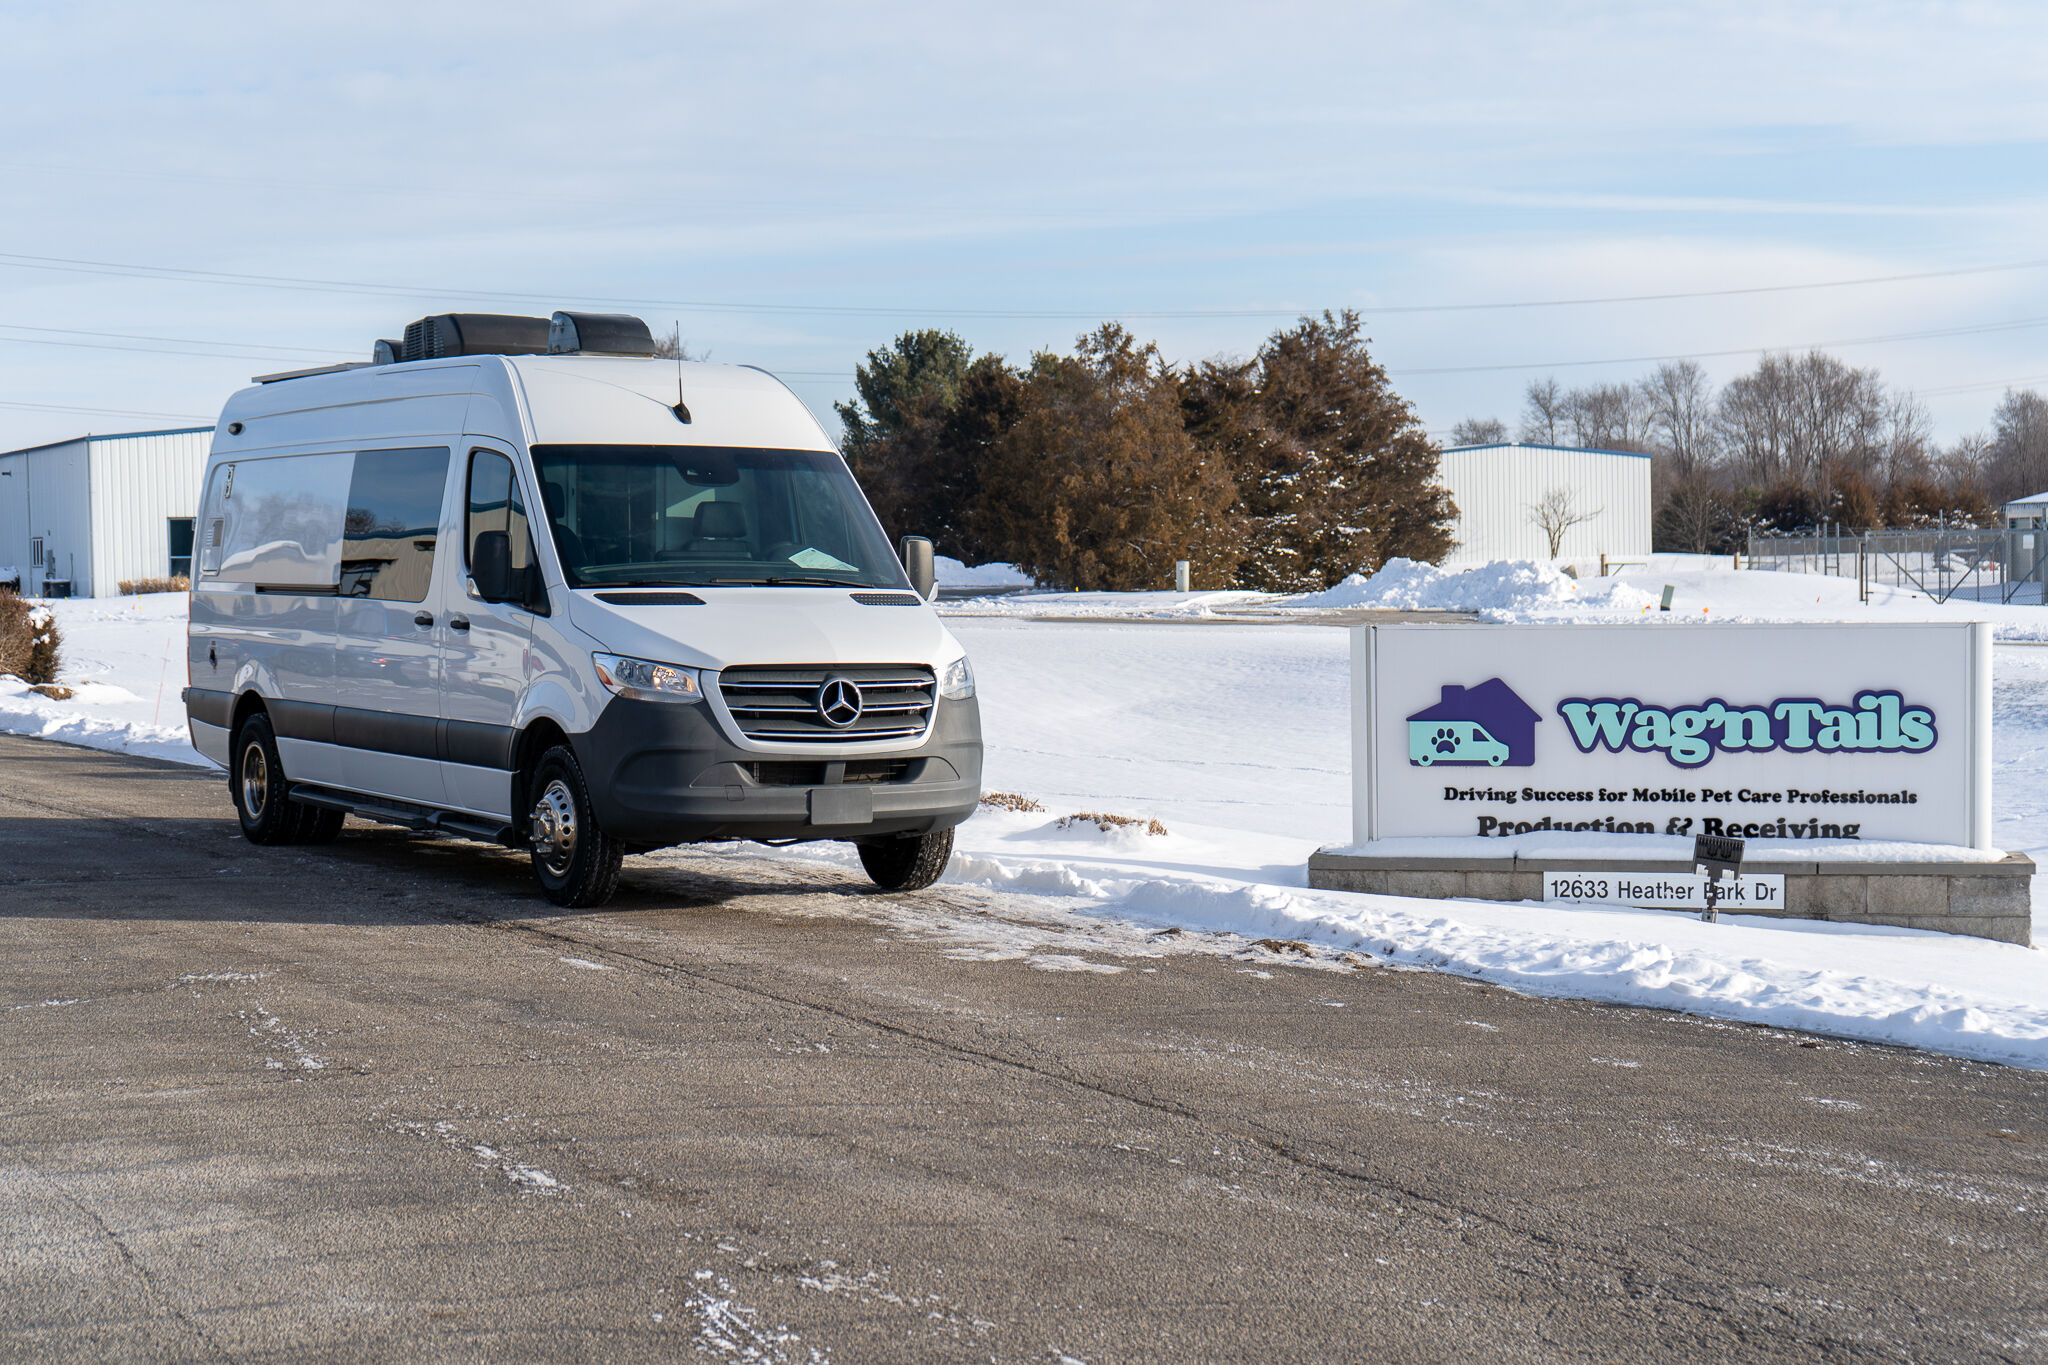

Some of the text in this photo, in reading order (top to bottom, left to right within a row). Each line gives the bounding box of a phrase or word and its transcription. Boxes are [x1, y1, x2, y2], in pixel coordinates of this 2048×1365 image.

[1561, 694, 1935, 765] Wag'n Tails
[1444, 786, 1918, 804] Driving Success for Mobile Pet Care Professionals
[1665, 816, 1693, 836] &
[1702, 817, 1861, 839] Receiving
[1550, 879, 1609, 899] 12633
[1617, 880, 1695, 900] Heather
[1755, 882, 1777, 901] Dr
